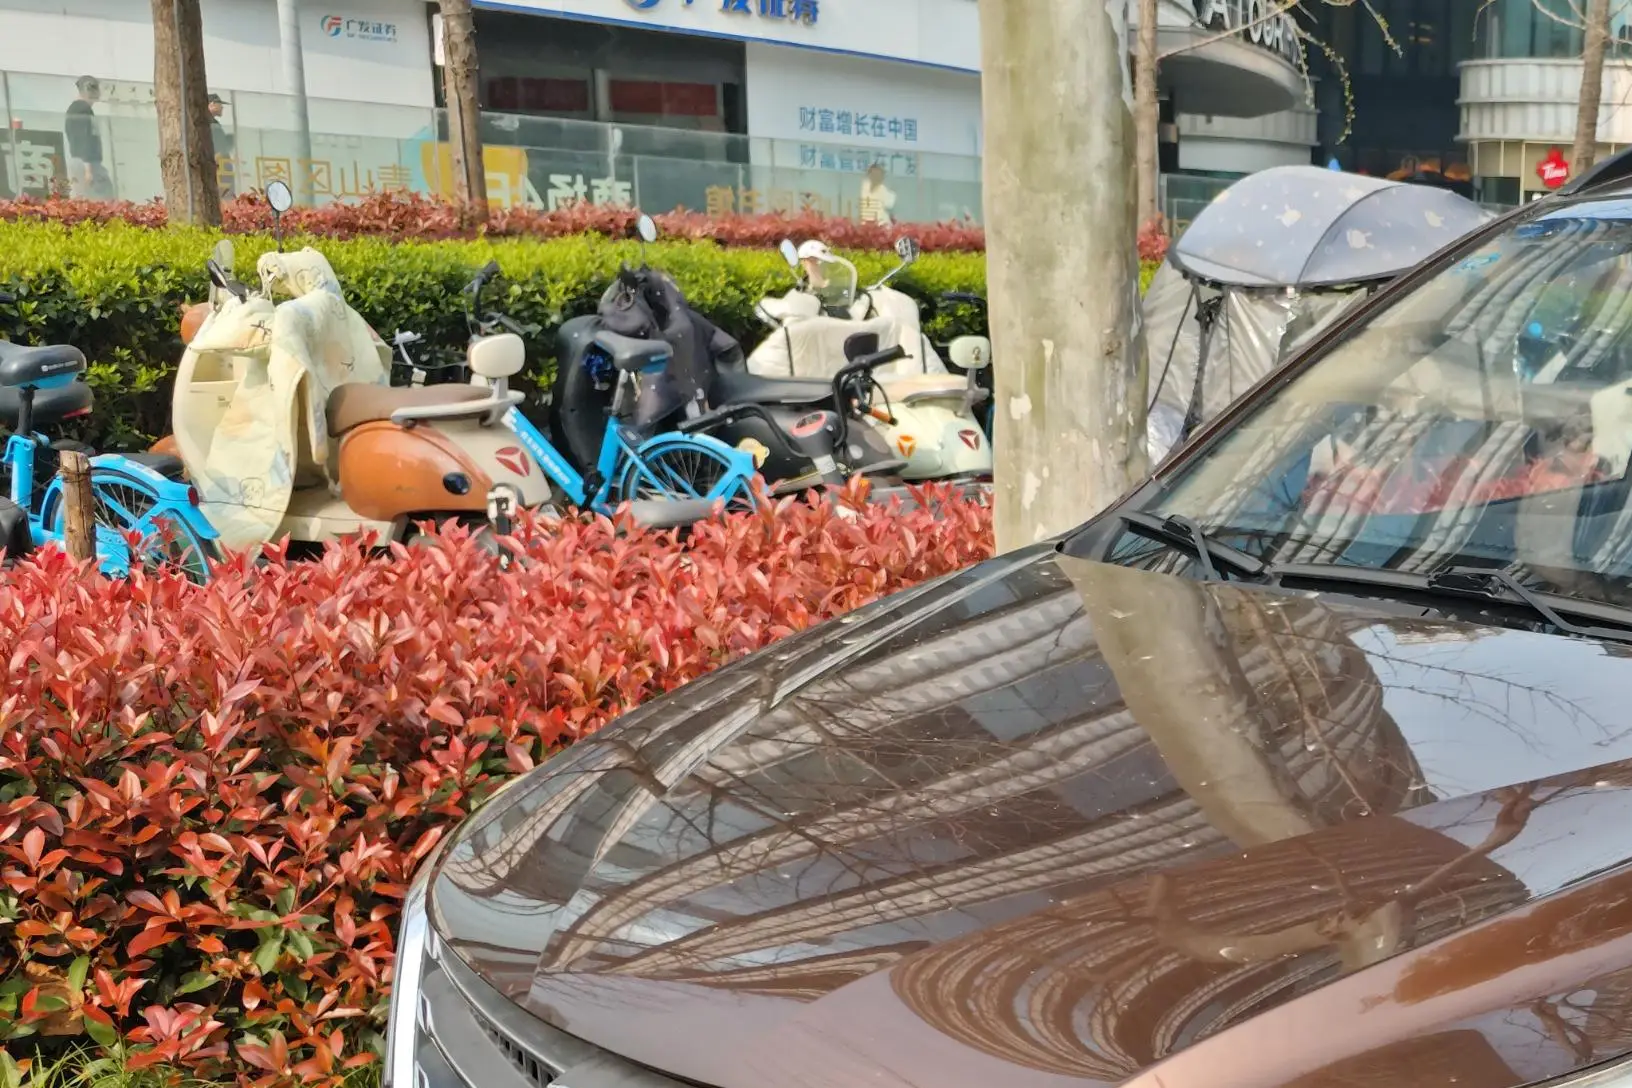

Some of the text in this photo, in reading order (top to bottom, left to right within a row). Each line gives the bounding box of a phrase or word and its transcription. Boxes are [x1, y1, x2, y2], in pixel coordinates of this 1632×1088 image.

[799, 106, 918, 142] 财富增长在中国
